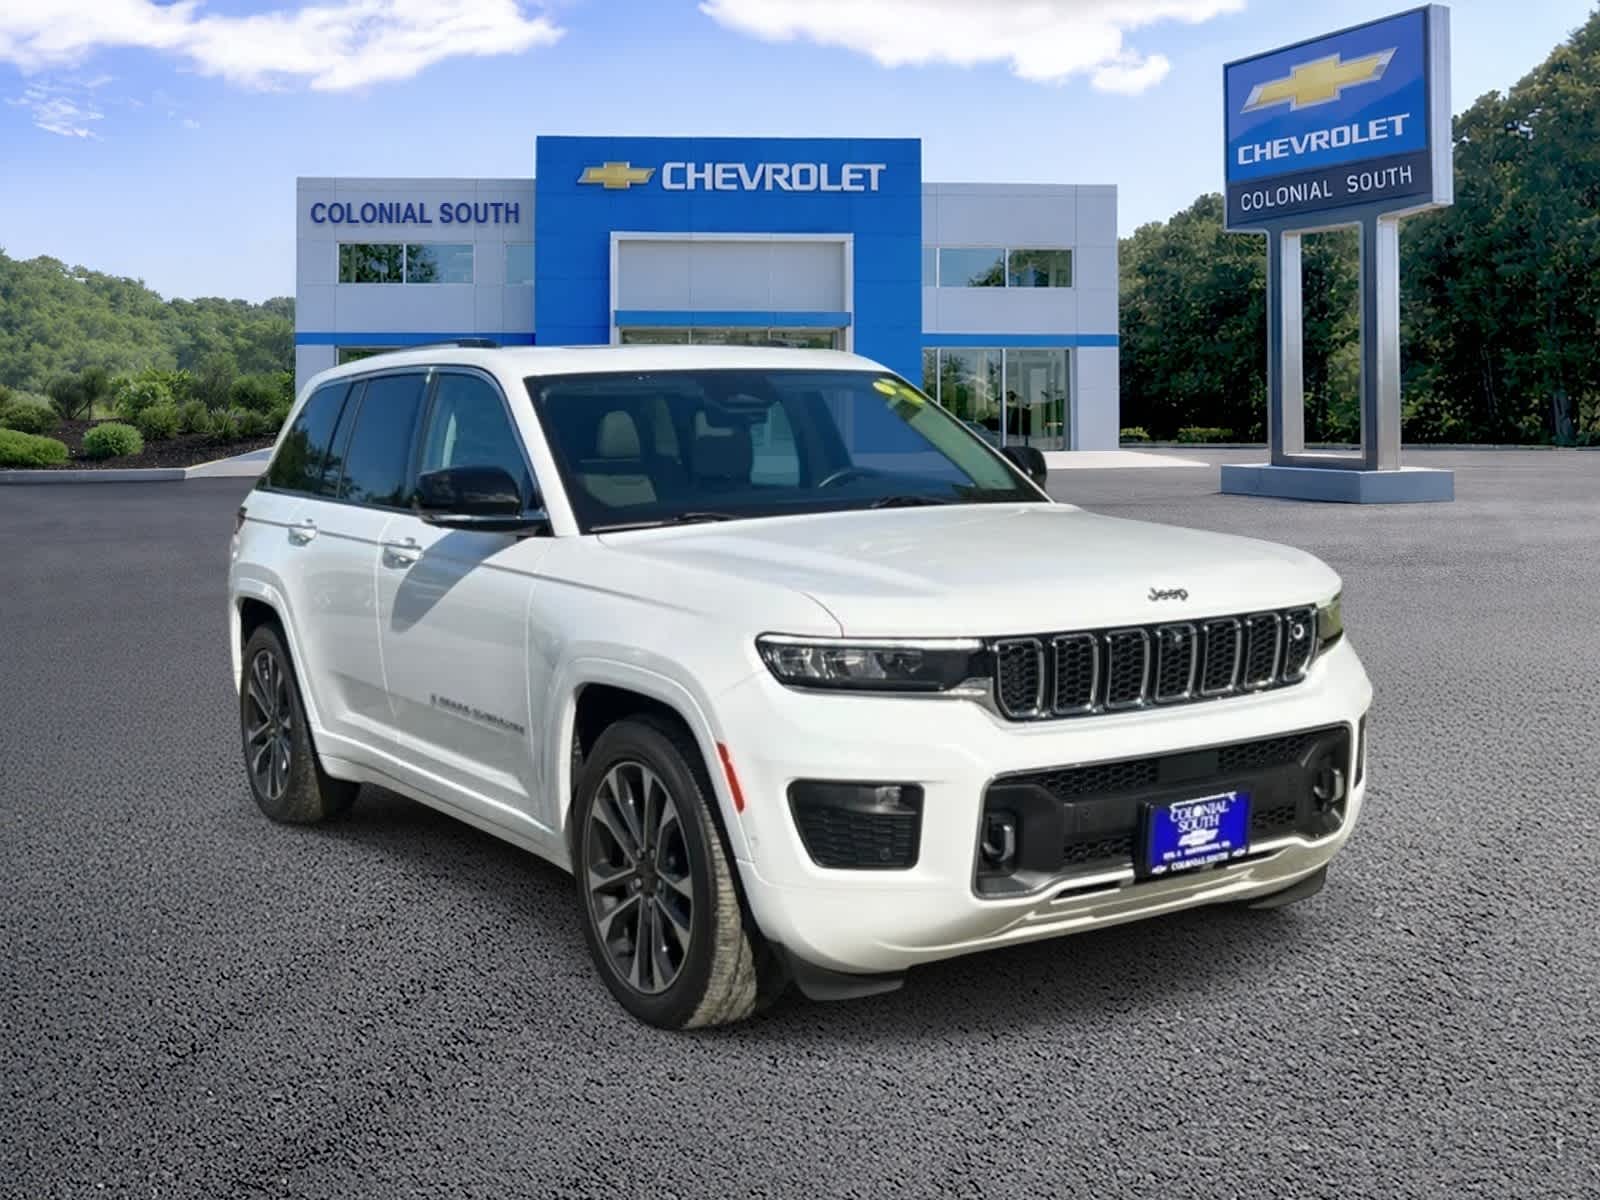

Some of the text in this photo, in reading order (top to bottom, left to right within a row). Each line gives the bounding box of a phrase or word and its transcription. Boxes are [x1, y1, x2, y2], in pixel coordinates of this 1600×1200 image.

[1237, 113, 1410, 165] CHEVROLET
[661, 161, 887, 192] CHEVROLET
[1240, 164, 1413, 212] COLONIAL SOUTH
[310, 202, 520, 225] COLONIAL SOUTH
[1147, 587, 1189, 602] Jeep
[1169, 800, 1230, 822] COLONIAL
[1177, 813, 1220, 834] SOUTH
